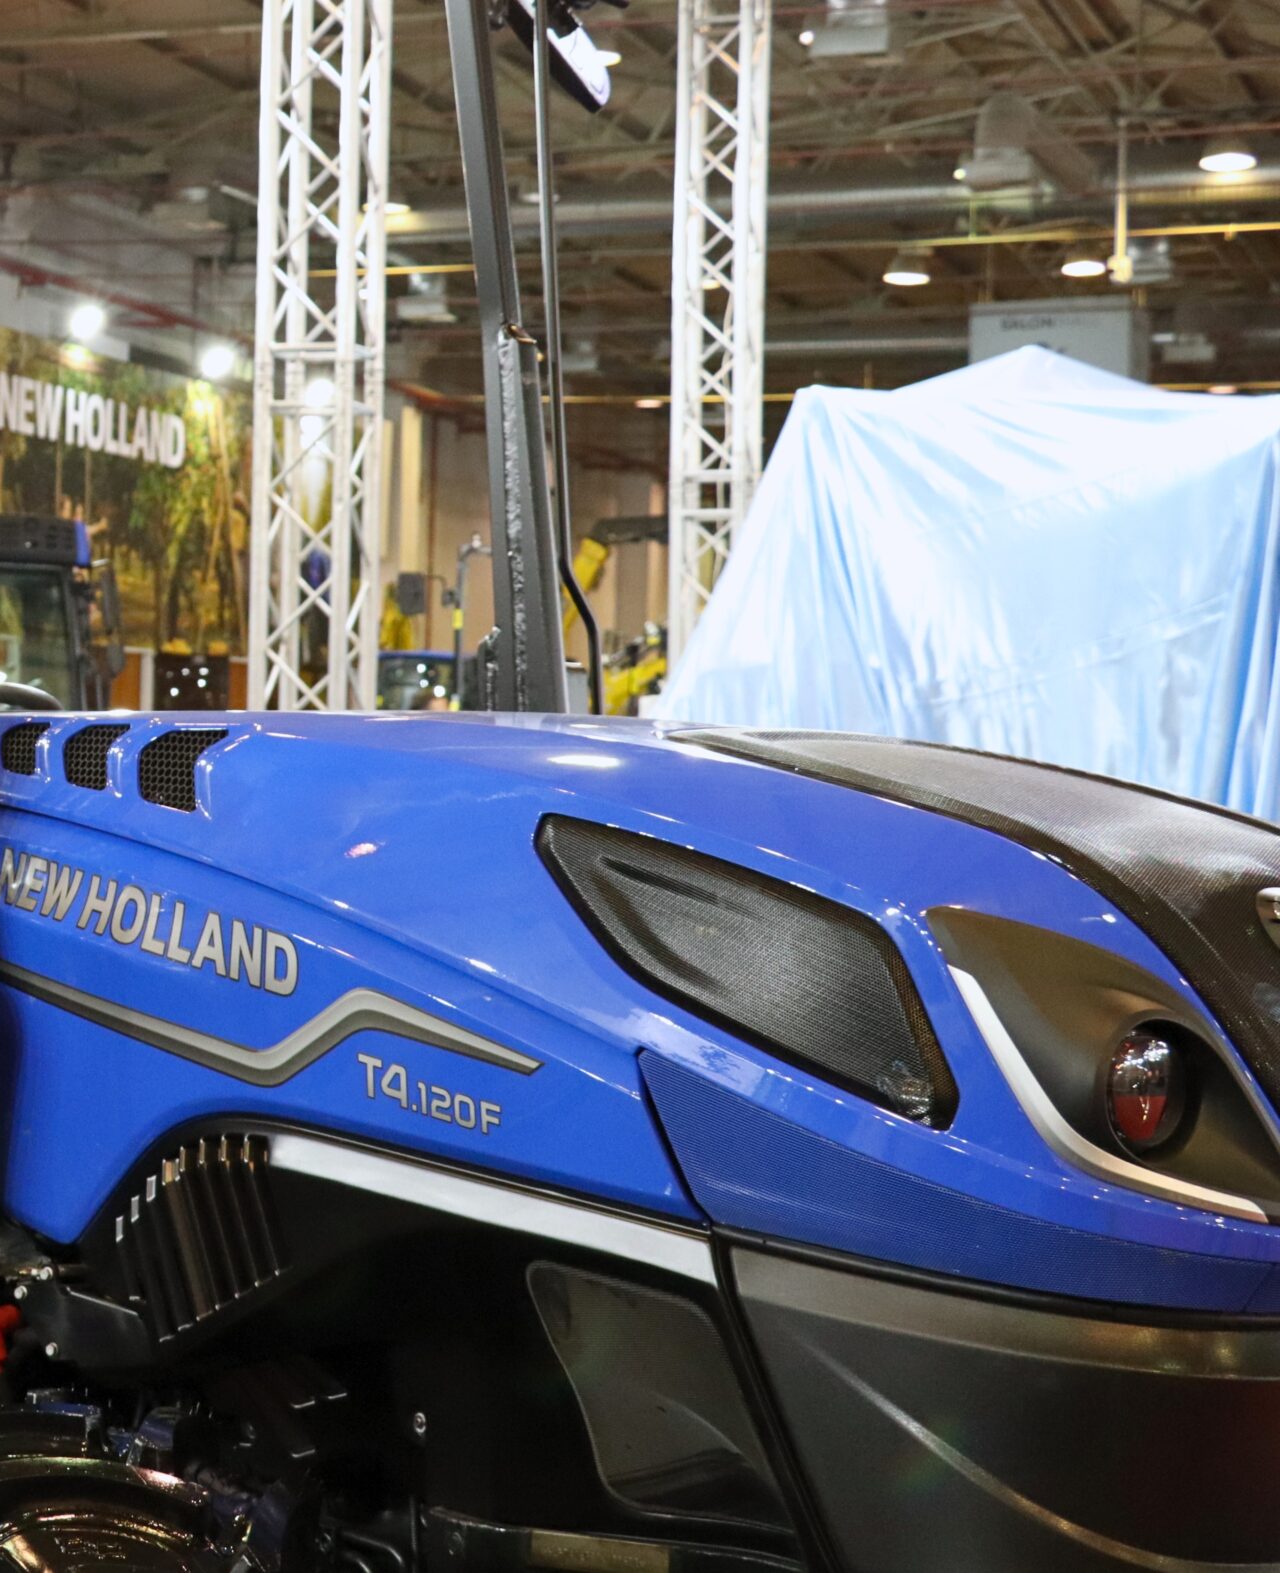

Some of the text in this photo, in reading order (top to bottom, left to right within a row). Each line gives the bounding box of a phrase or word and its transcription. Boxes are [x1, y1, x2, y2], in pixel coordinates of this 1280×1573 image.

[65, 387, 186, 469] HOLLAND
[76, 874, 299, 998] HOLLAND
[357, 1052, 503, 1135] T4.120F
